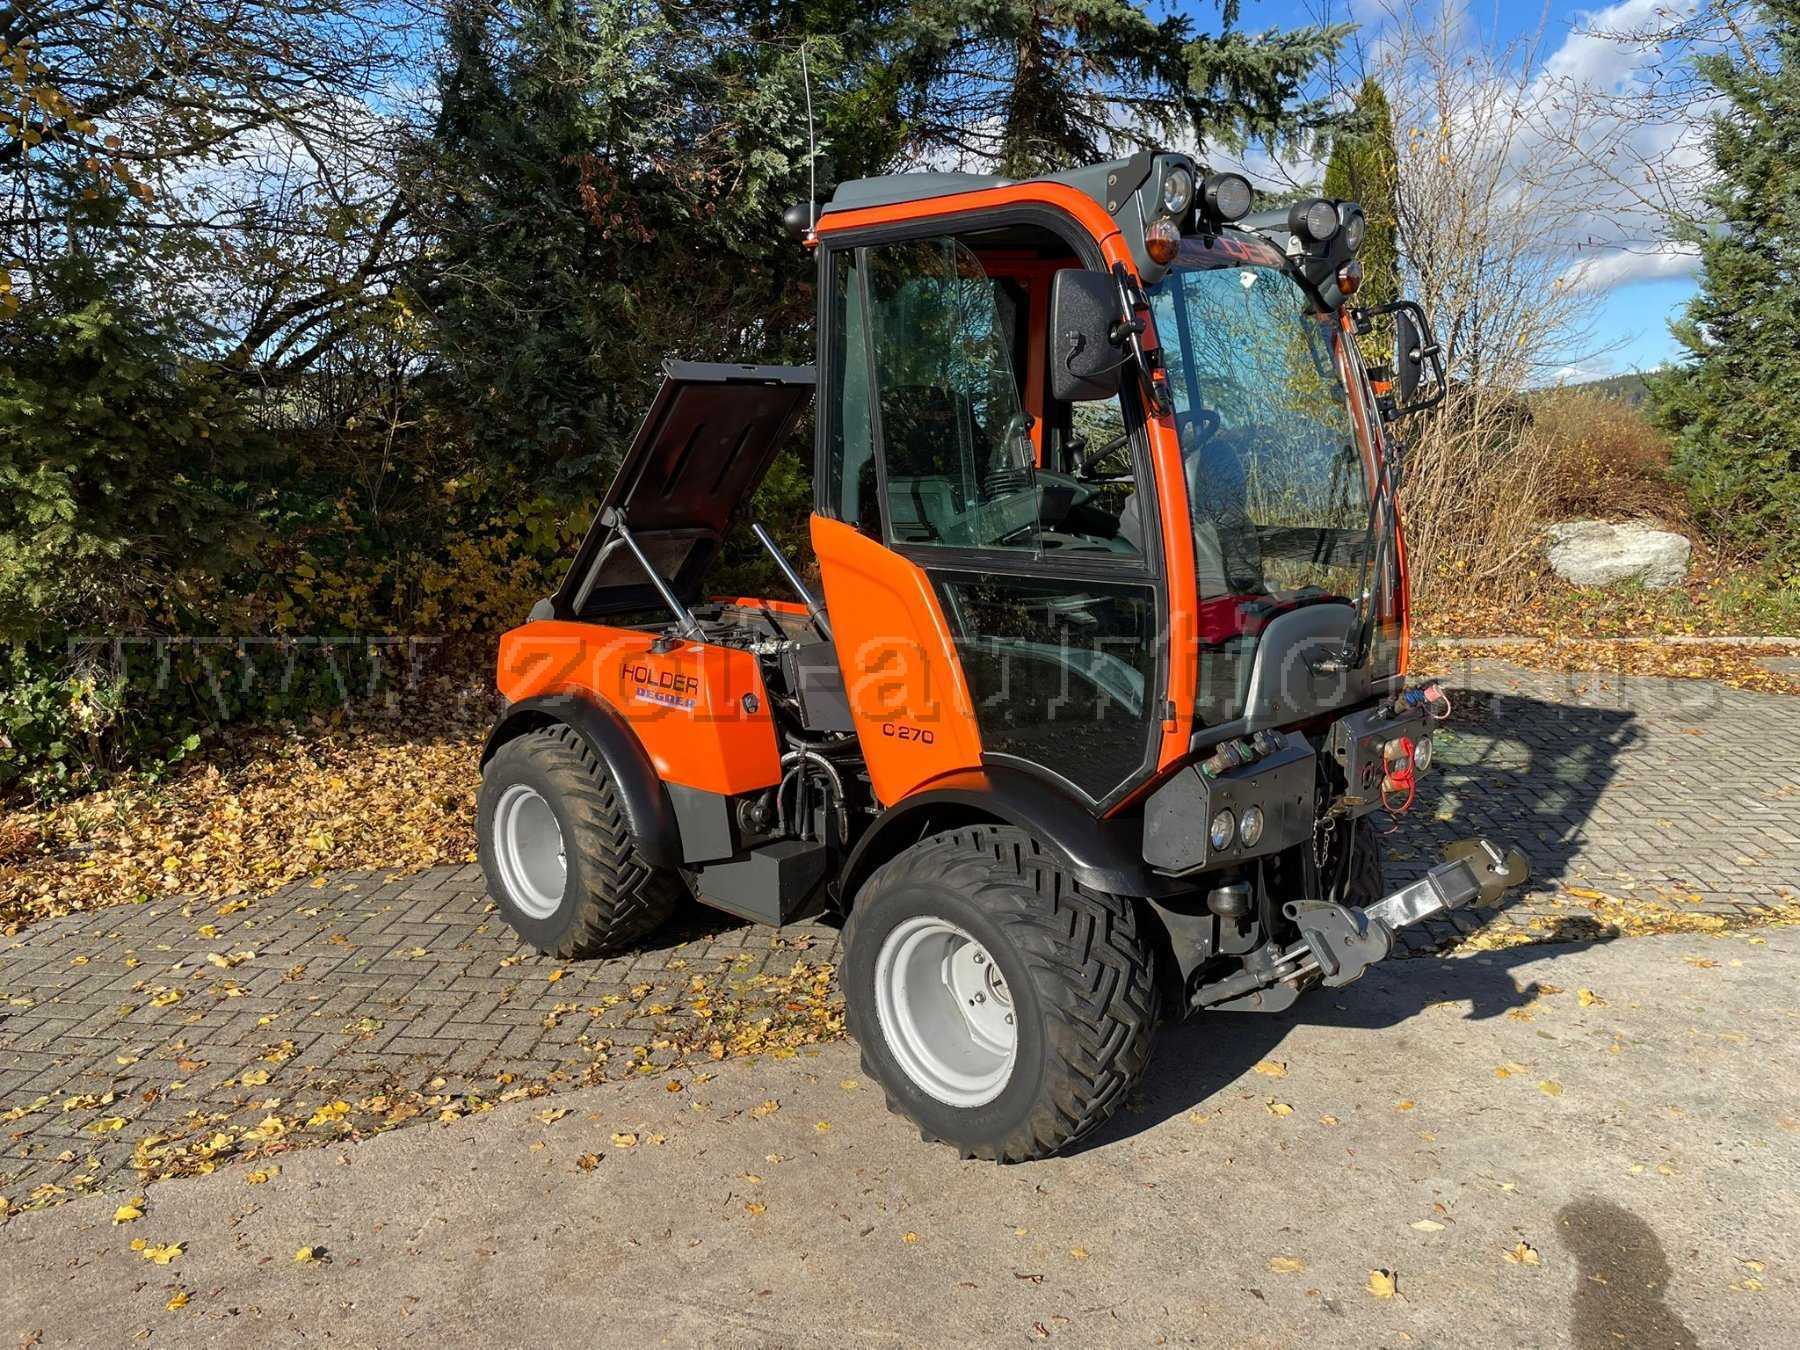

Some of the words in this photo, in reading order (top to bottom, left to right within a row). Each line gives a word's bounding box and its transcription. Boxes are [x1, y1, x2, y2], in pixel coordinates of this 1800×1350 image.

[621, 663, 699, 695] HOLDER
[882, 722, 895, 737] C
[898, 726, 935, 745] 270
